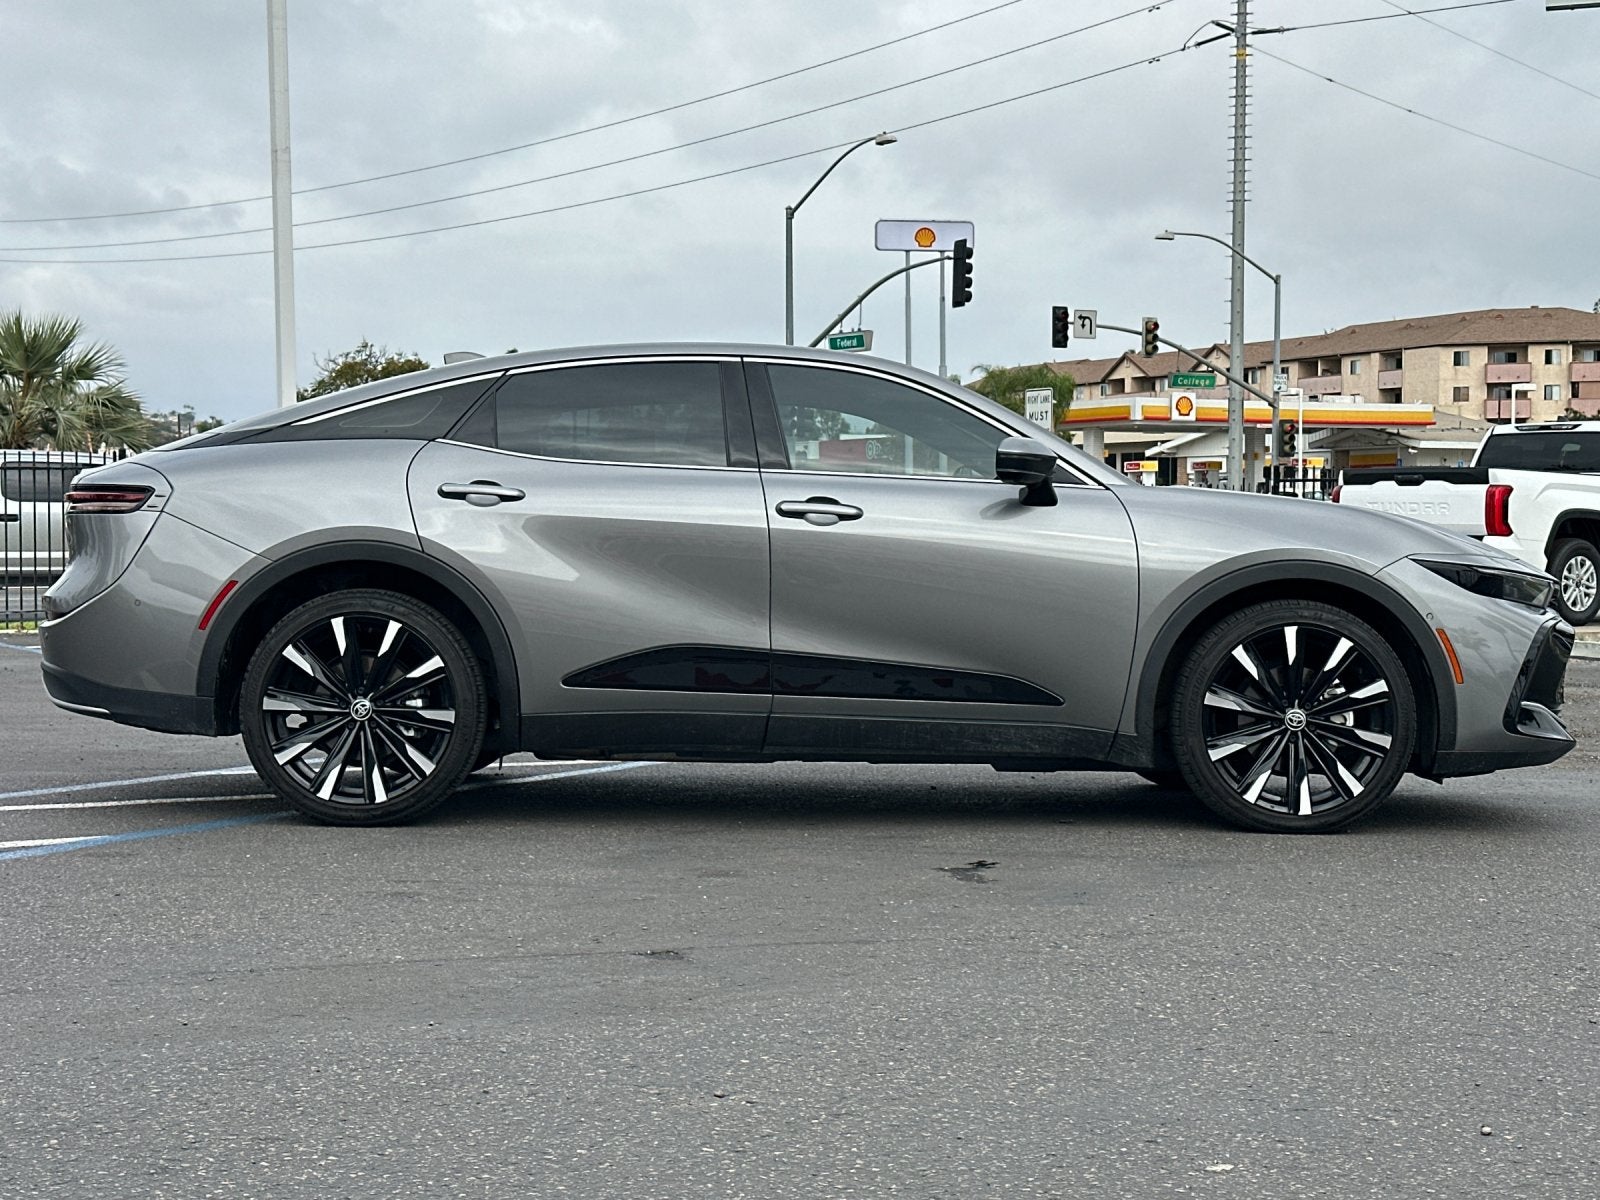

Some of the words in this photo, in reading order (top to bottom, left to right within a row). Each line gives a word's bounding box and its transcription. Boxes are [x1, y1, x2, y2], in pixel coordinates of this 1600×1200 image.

[836, 337, 858, 349] Federal
[1177, 377, 1210, 387] College
[1027, 395, 1039, 405] RIGHT
[1040, 394, 1051, 404] LANE
[1028, 410, 1049, 421] MUST
